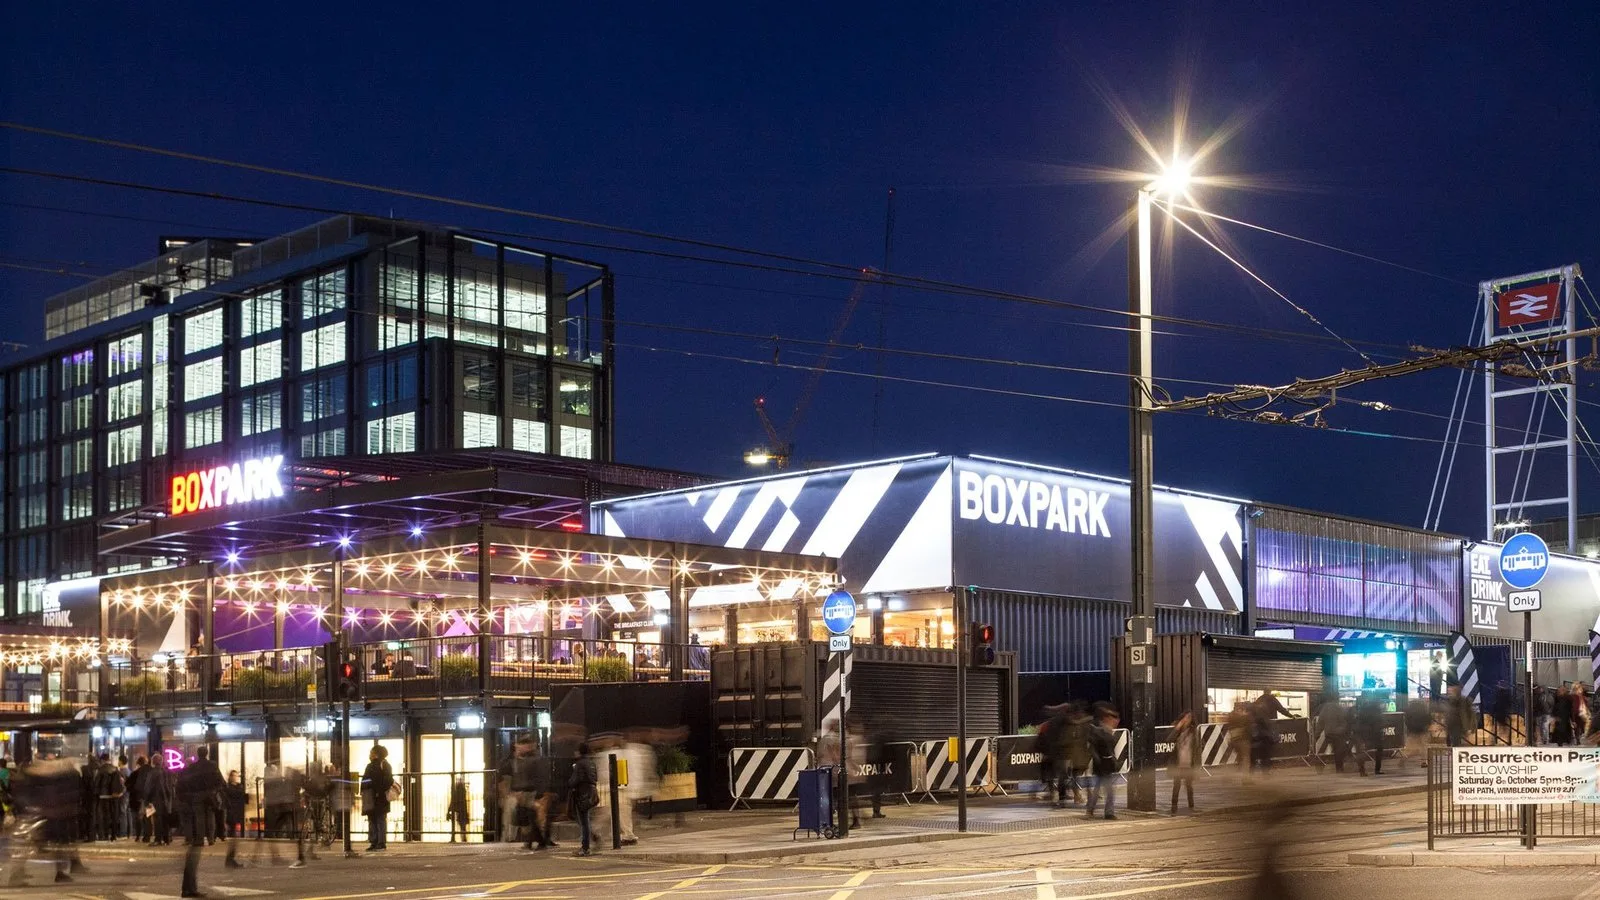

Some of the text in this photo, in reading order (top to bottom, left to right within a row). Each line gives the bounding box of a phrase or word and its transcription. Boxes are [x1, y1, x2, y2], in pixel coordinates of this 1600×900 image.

[172, 455, 284, 515] BOXPARK
[959, 470, 1111, 538] BOXPARK
[1471, 579, 1505, 602] DRINK.
[1513, 596, 1536, 606] Only
[1472, 604, 1498, 626] PLAY.
[832, 639, 848, 648] Only
[1154, 742, 1176, 754] OXPAR
[1458, 751, 1562, 763] Resurrection
[1458, 765, 1539, 775] FELLOWSHIP
[1458, 776, 1494, 786] Saturday
[1507, 776, 1538, 785] October
[1477, 787, 1496, 795] PATH,
[1541, 786, 1562, 794] SW19
